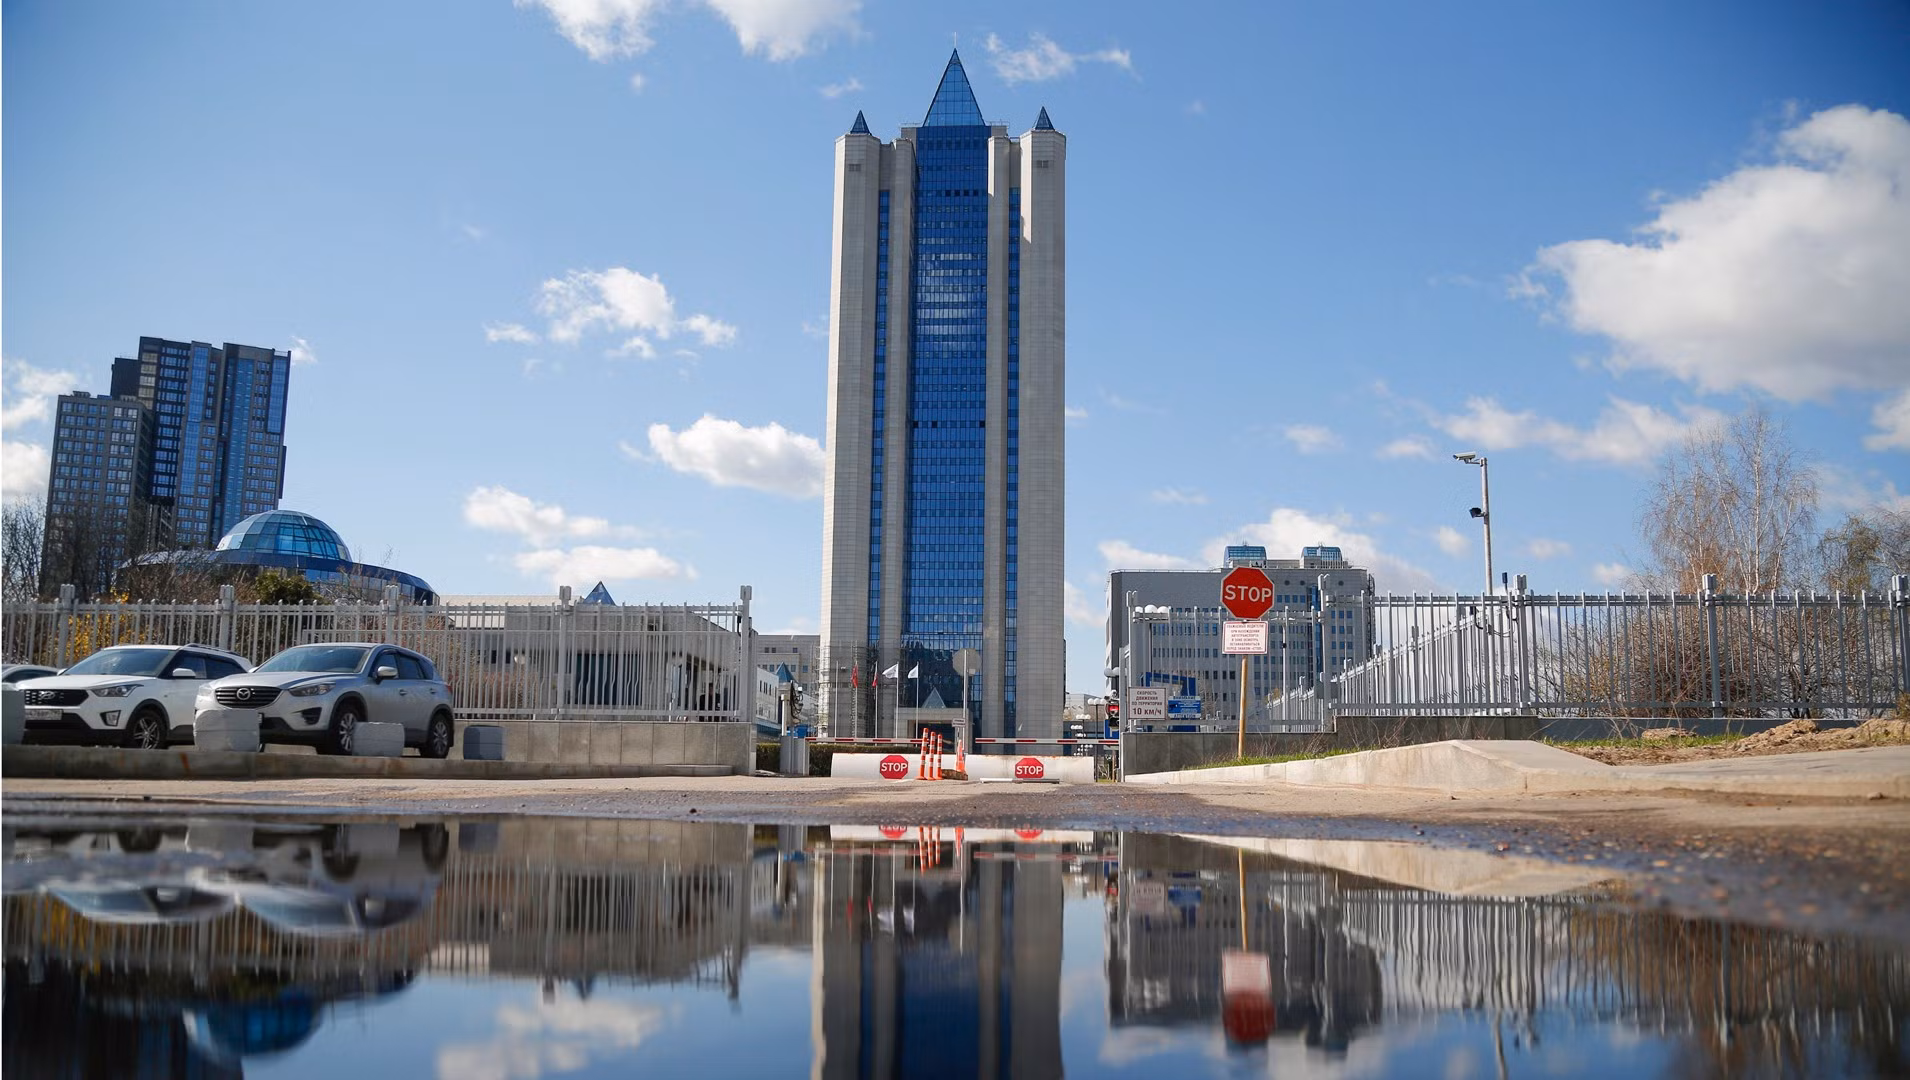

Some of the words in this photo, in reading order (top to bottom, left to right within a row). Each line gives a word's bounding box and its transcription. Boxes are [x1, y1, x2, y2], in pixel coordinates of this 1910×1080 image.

[1224, 584, 1272, 603] STOP
[880, 762, 908, 772] STOP
[1016, 765, 1043, 775] STOP
